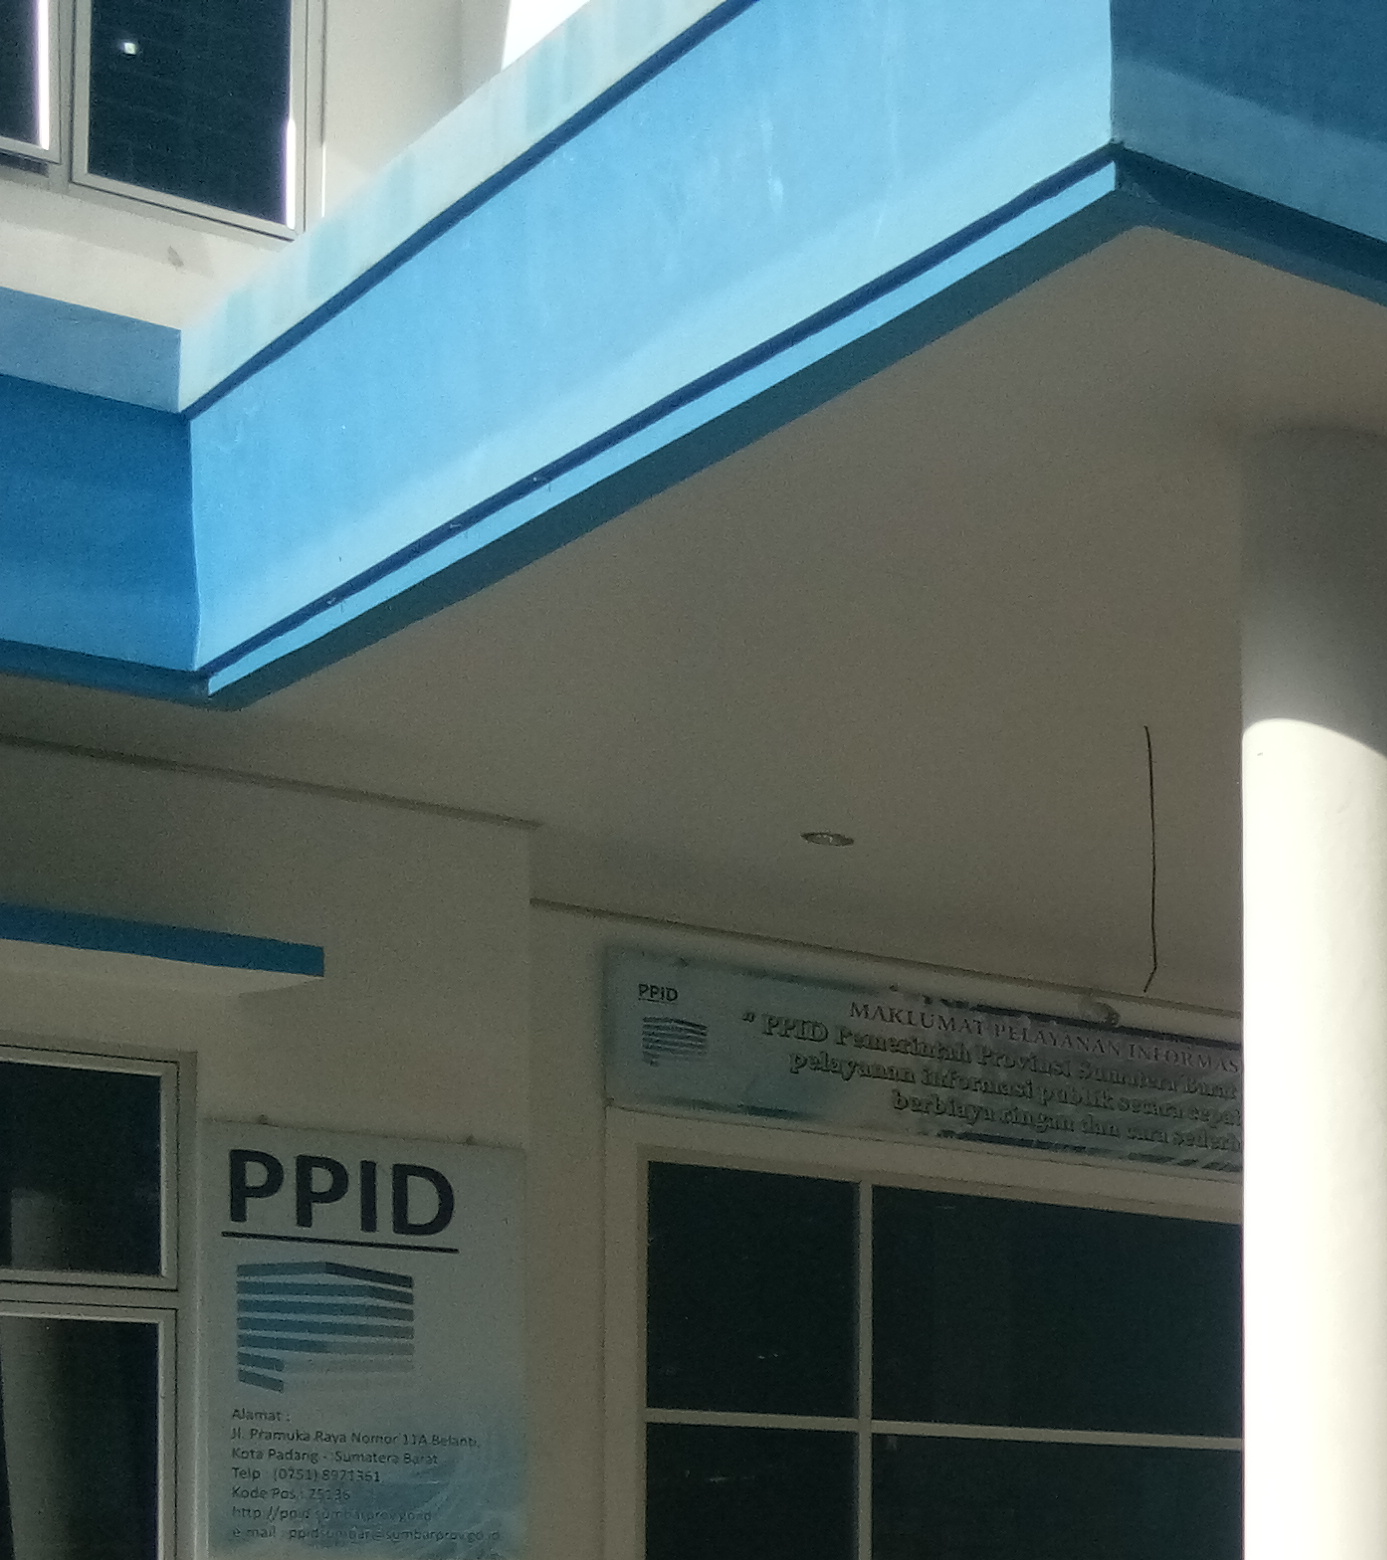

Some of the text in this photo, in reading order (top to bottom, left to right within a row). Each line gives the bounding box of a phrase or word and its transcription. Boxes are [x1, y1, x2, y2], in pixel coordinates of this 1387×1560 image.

[638, 983, 679, 1001] PPID
[850, 1002, 1240, 1073] MAKLUMAT PELAYANAN INFORMAS
[789, 1051, 916, 1081] pelayanan
[1037, 1085, 1114, 1111] publik
[229, 1149, 456, 1236] PPID
[250, 1428, 311, 1442] Pramuka
[314, 1430, 347, 1444] Raya
[350, 1431, 398, 1445] Nomor
[232, 1447, 264, 1460] Kota
[268, 1448, 319, 1464] Padang
[334, 1450, 399, 1465] Sumatera
[403, 1453, 438, 1465] Barat
[232, 1485, 268, 1499] Kode
